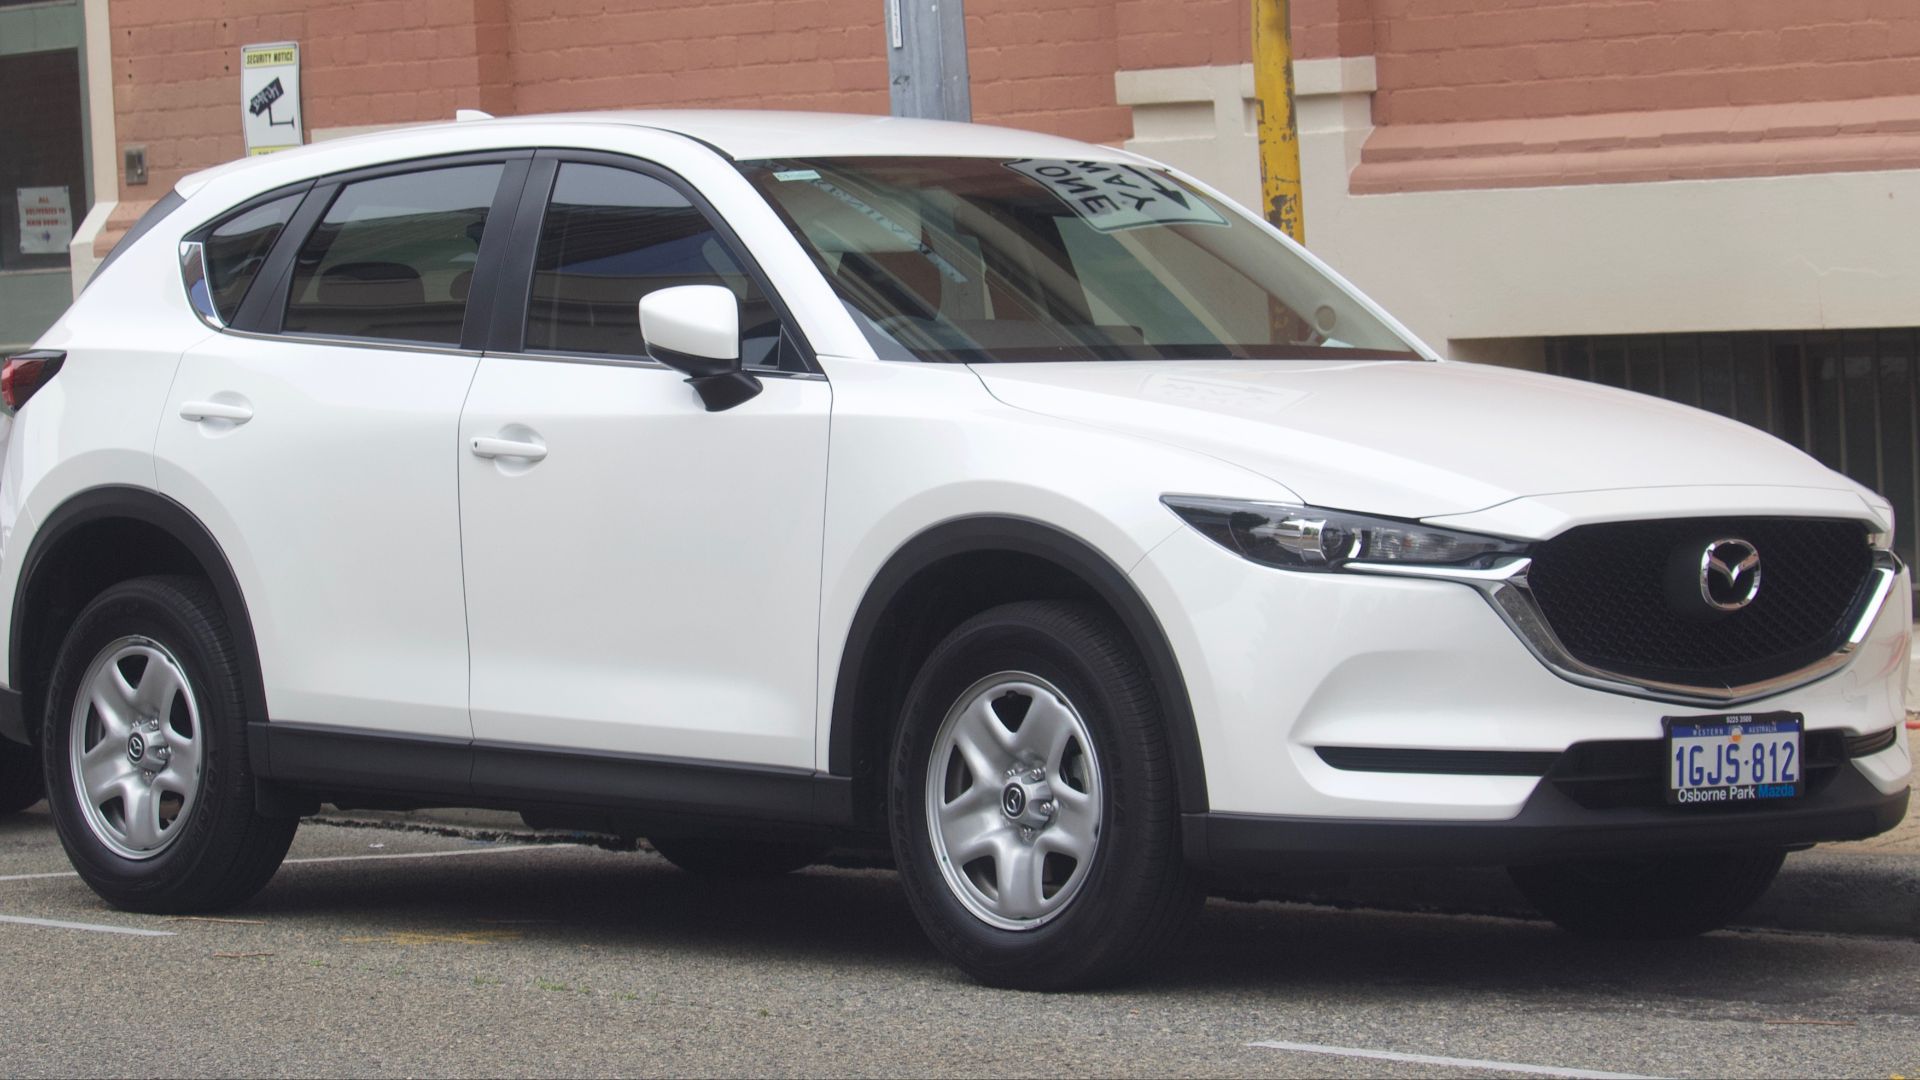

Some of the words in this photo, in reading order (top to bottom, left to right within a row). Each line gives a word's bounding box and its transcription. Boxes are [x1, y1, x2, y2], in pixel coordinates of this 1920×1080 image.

[246, 53, 272, 64] SECURITY
[273, 51, 293, 62] NOTICE
[1692, 728, 1724, 736] WESTERN
[1678, 788, 1727, 802] Osborne
[1729, 786, 1756, 800] Park
[1757, 784, 1795, 797] Mazda
